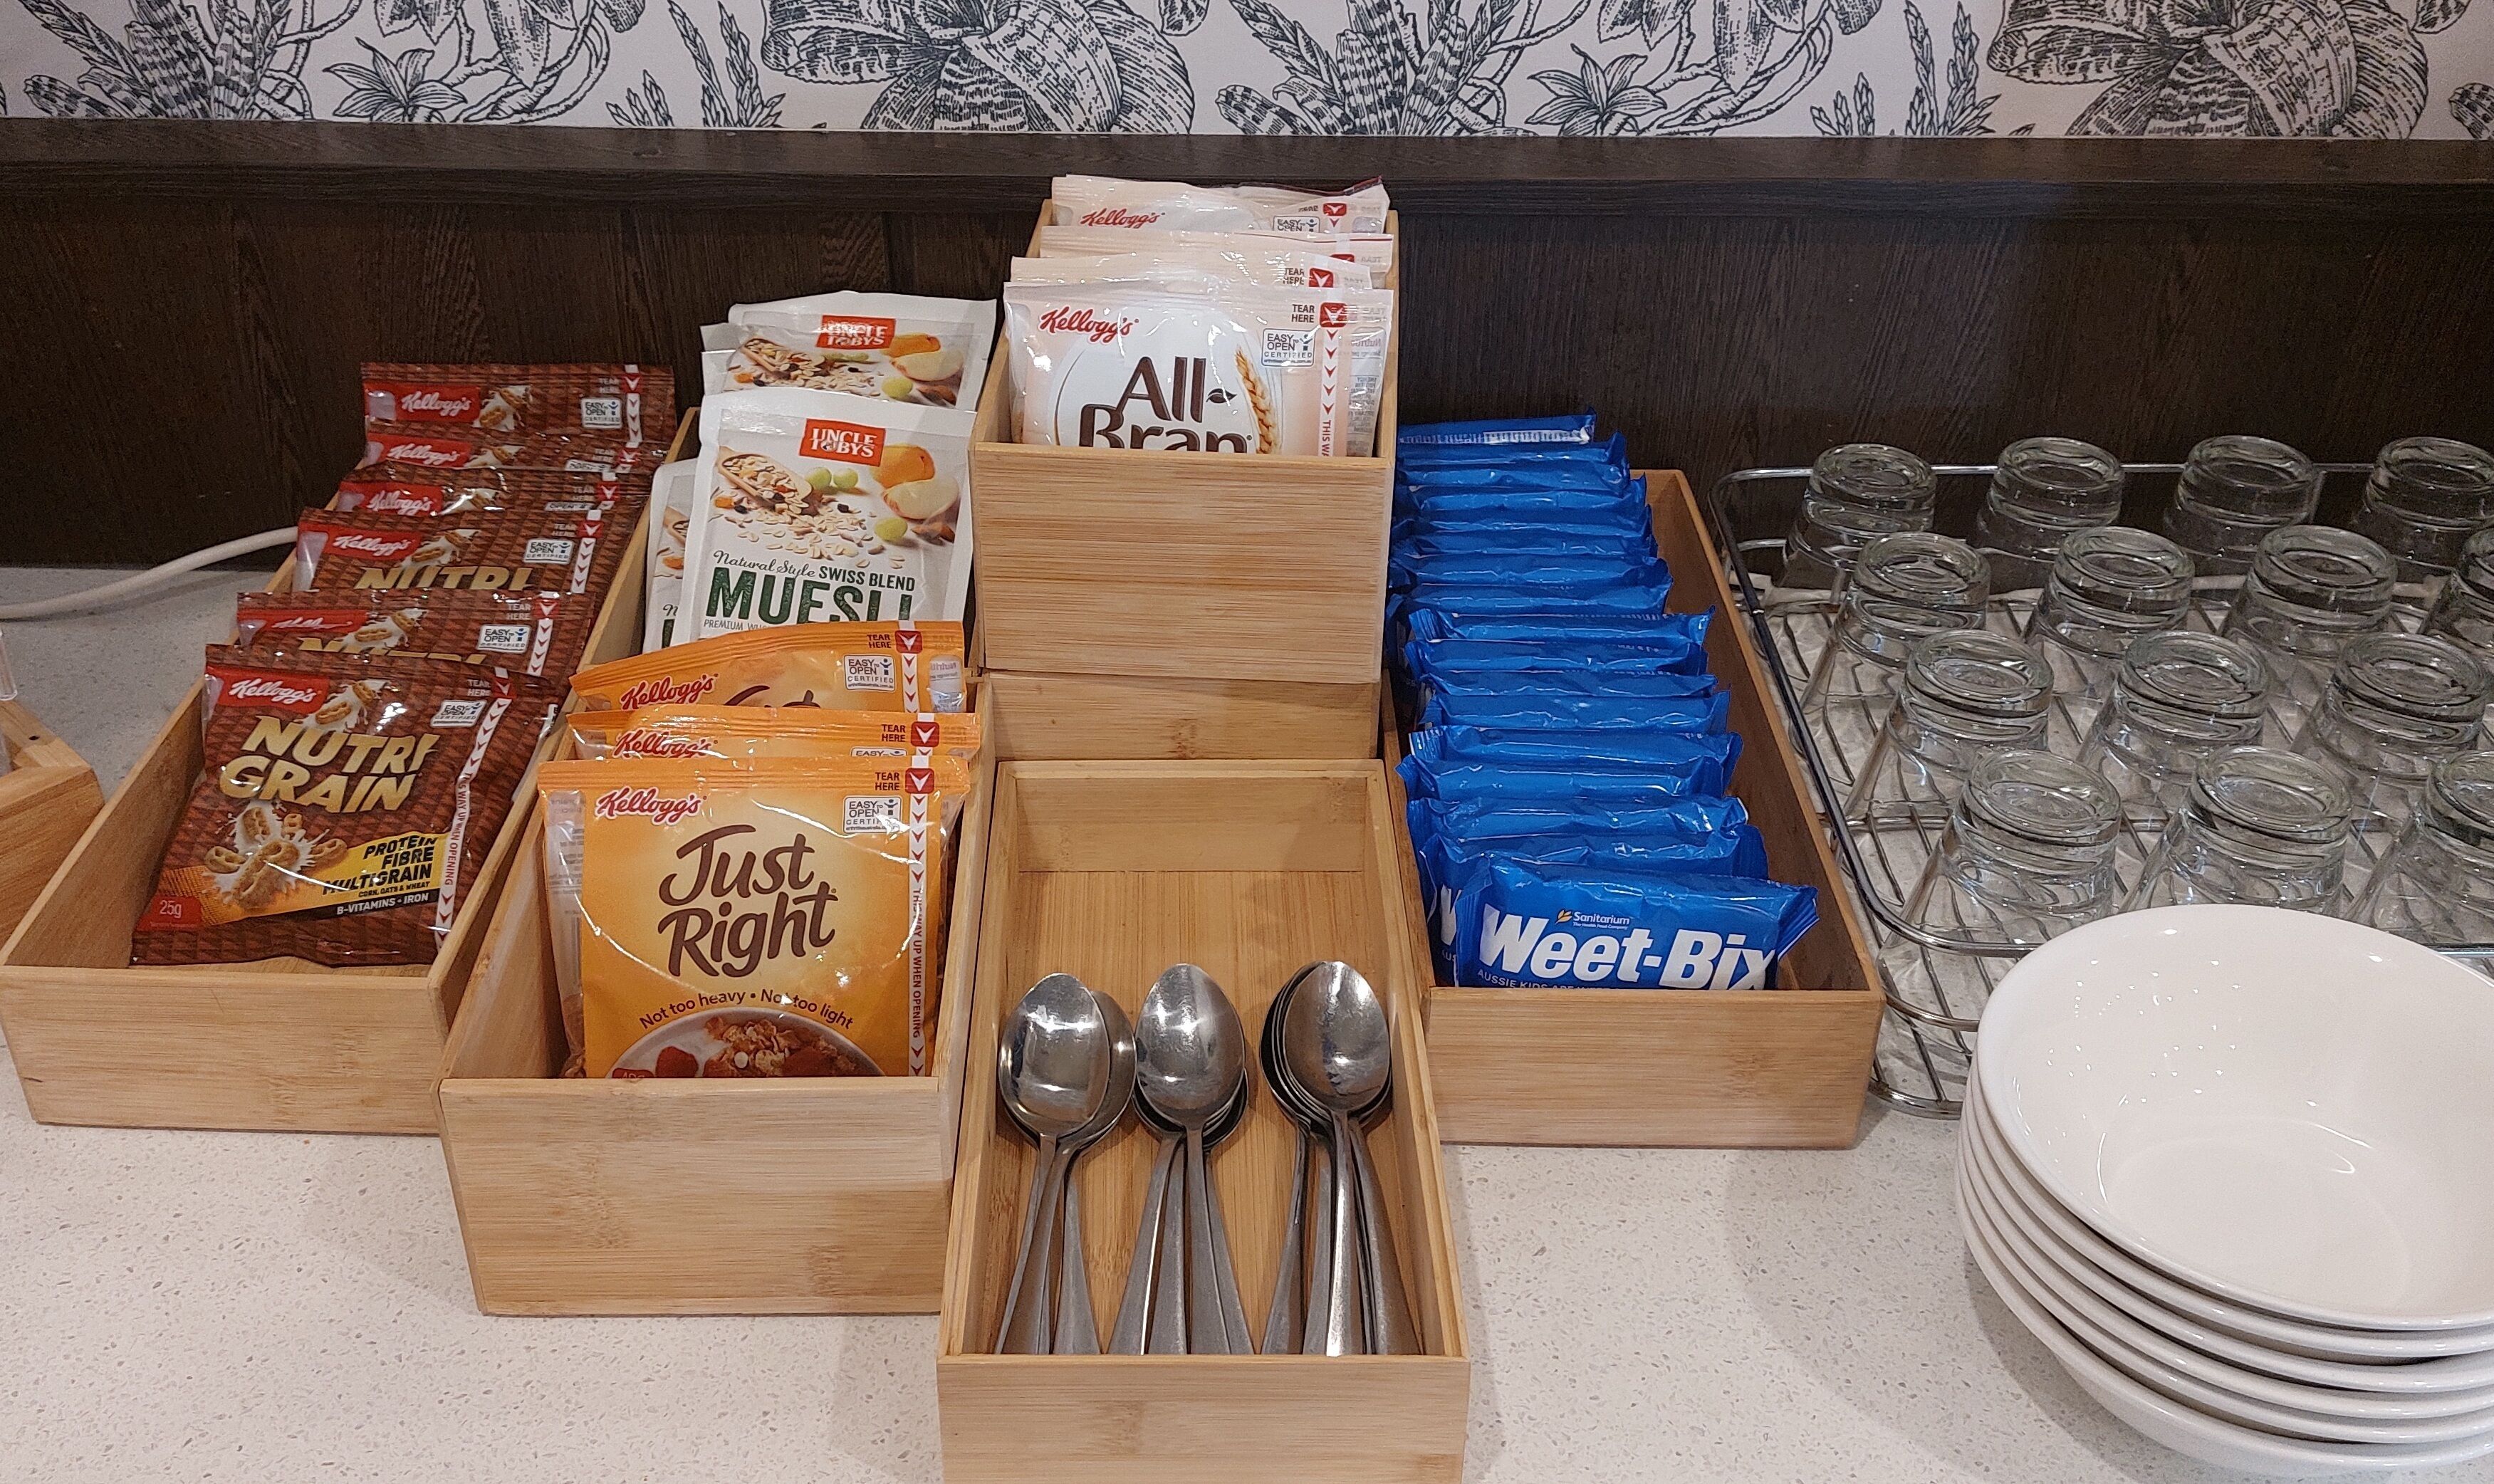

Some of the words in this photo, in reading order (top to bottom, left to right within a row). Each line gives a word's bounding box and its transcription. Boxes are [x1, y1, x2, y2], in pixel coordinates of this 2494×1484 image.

[1080, 207, 1160, 229] Kellogg's
[1291, 314, 1315, 323] HERE
[1292, 304, 1315, 313] TEAR
[1040, 306, 1134, 343] Kellogg's
[1267, 334, 1295, 343] EASY
[1267, 342, 1295, 351] OPEN
[1115, 356, 1206, 424] All
[400, 390, 472, 417] Kellogg's
[812, 428, 877, 446] UNCLE
[1322, 420, 1331, 441] THIS
[387, 443, 461, 466] Kellogg's
[810, 438, 875, 457] TOBYS
[366, 489, 434, 516] Kellogg's
[333, 535, 412, 557] Kellogg's
[713, 550, 775, 572] Natural
[776, 560, 817, 579] Style
[818, 565, 865, 585] SWISS
[868, 573, 916, 592] BLEND
[703, 619, 743, 631] PREMIUM
[848, 659, 875, 667] EASY
[849, 667, 877, 676] OPEN
[228, 678, 318, 704] Kellogg's
[467, 679, 491, 688] TEAR
[467, 688, 492, 697] HERE
[620, 674, 714, 711] Kellogg's
[444, 704, 468, 713] EASY
[881, 733, 906, 742] HERE
[882, 724, 906, 733] TEAR
[241, 714, 441, 775] NUTRI
[613, 729, 713, 758] Kellogg's
[219, 755, 418, 814] GRAIN
[875, 772, 900, 781] TEAR
[875, 782, 900, 791] HERE
[456, 790, 467, 812] WAY
[595, 787, 702, 824] Kellogg's
[849, 800, 878, 810] EASY
[848, 809, 880, 817] OPEN
[362, 835, 439, 860] PROTEIN
[381, 845, 435, 870] FIBRE
[445, 842, 458, 886] OPENING
[659, 823, 815, 907] Just
[322, 862, 433, 896] MULTIGRAIN
[405, 881, 431, 892] WHEAT
[159, 899, 182, 919] 25g
[336, 897, 396, 916] B-VITAMINS
[402, 892, 429, 905] IRON
[657, 880, 839, 978] Right
[1573, 911, 1630, 925] Sanitarium
[913, 939, 922, 954] UP
[1479, 903, 1776, 991] Weet-Bix
[912, 956, 922, 988] WHEN
[1478, 968, 1517, 988] AUSSIE
[639, 1007, 669, 1030] Not
[669, 997, 696, 1014] too
[698, 991, 746, 1008] heavy
[792, 994, 818, 1013] too
[820, 1002, 854, 1030] light
[912, 990, 922, 1038] OPENING
